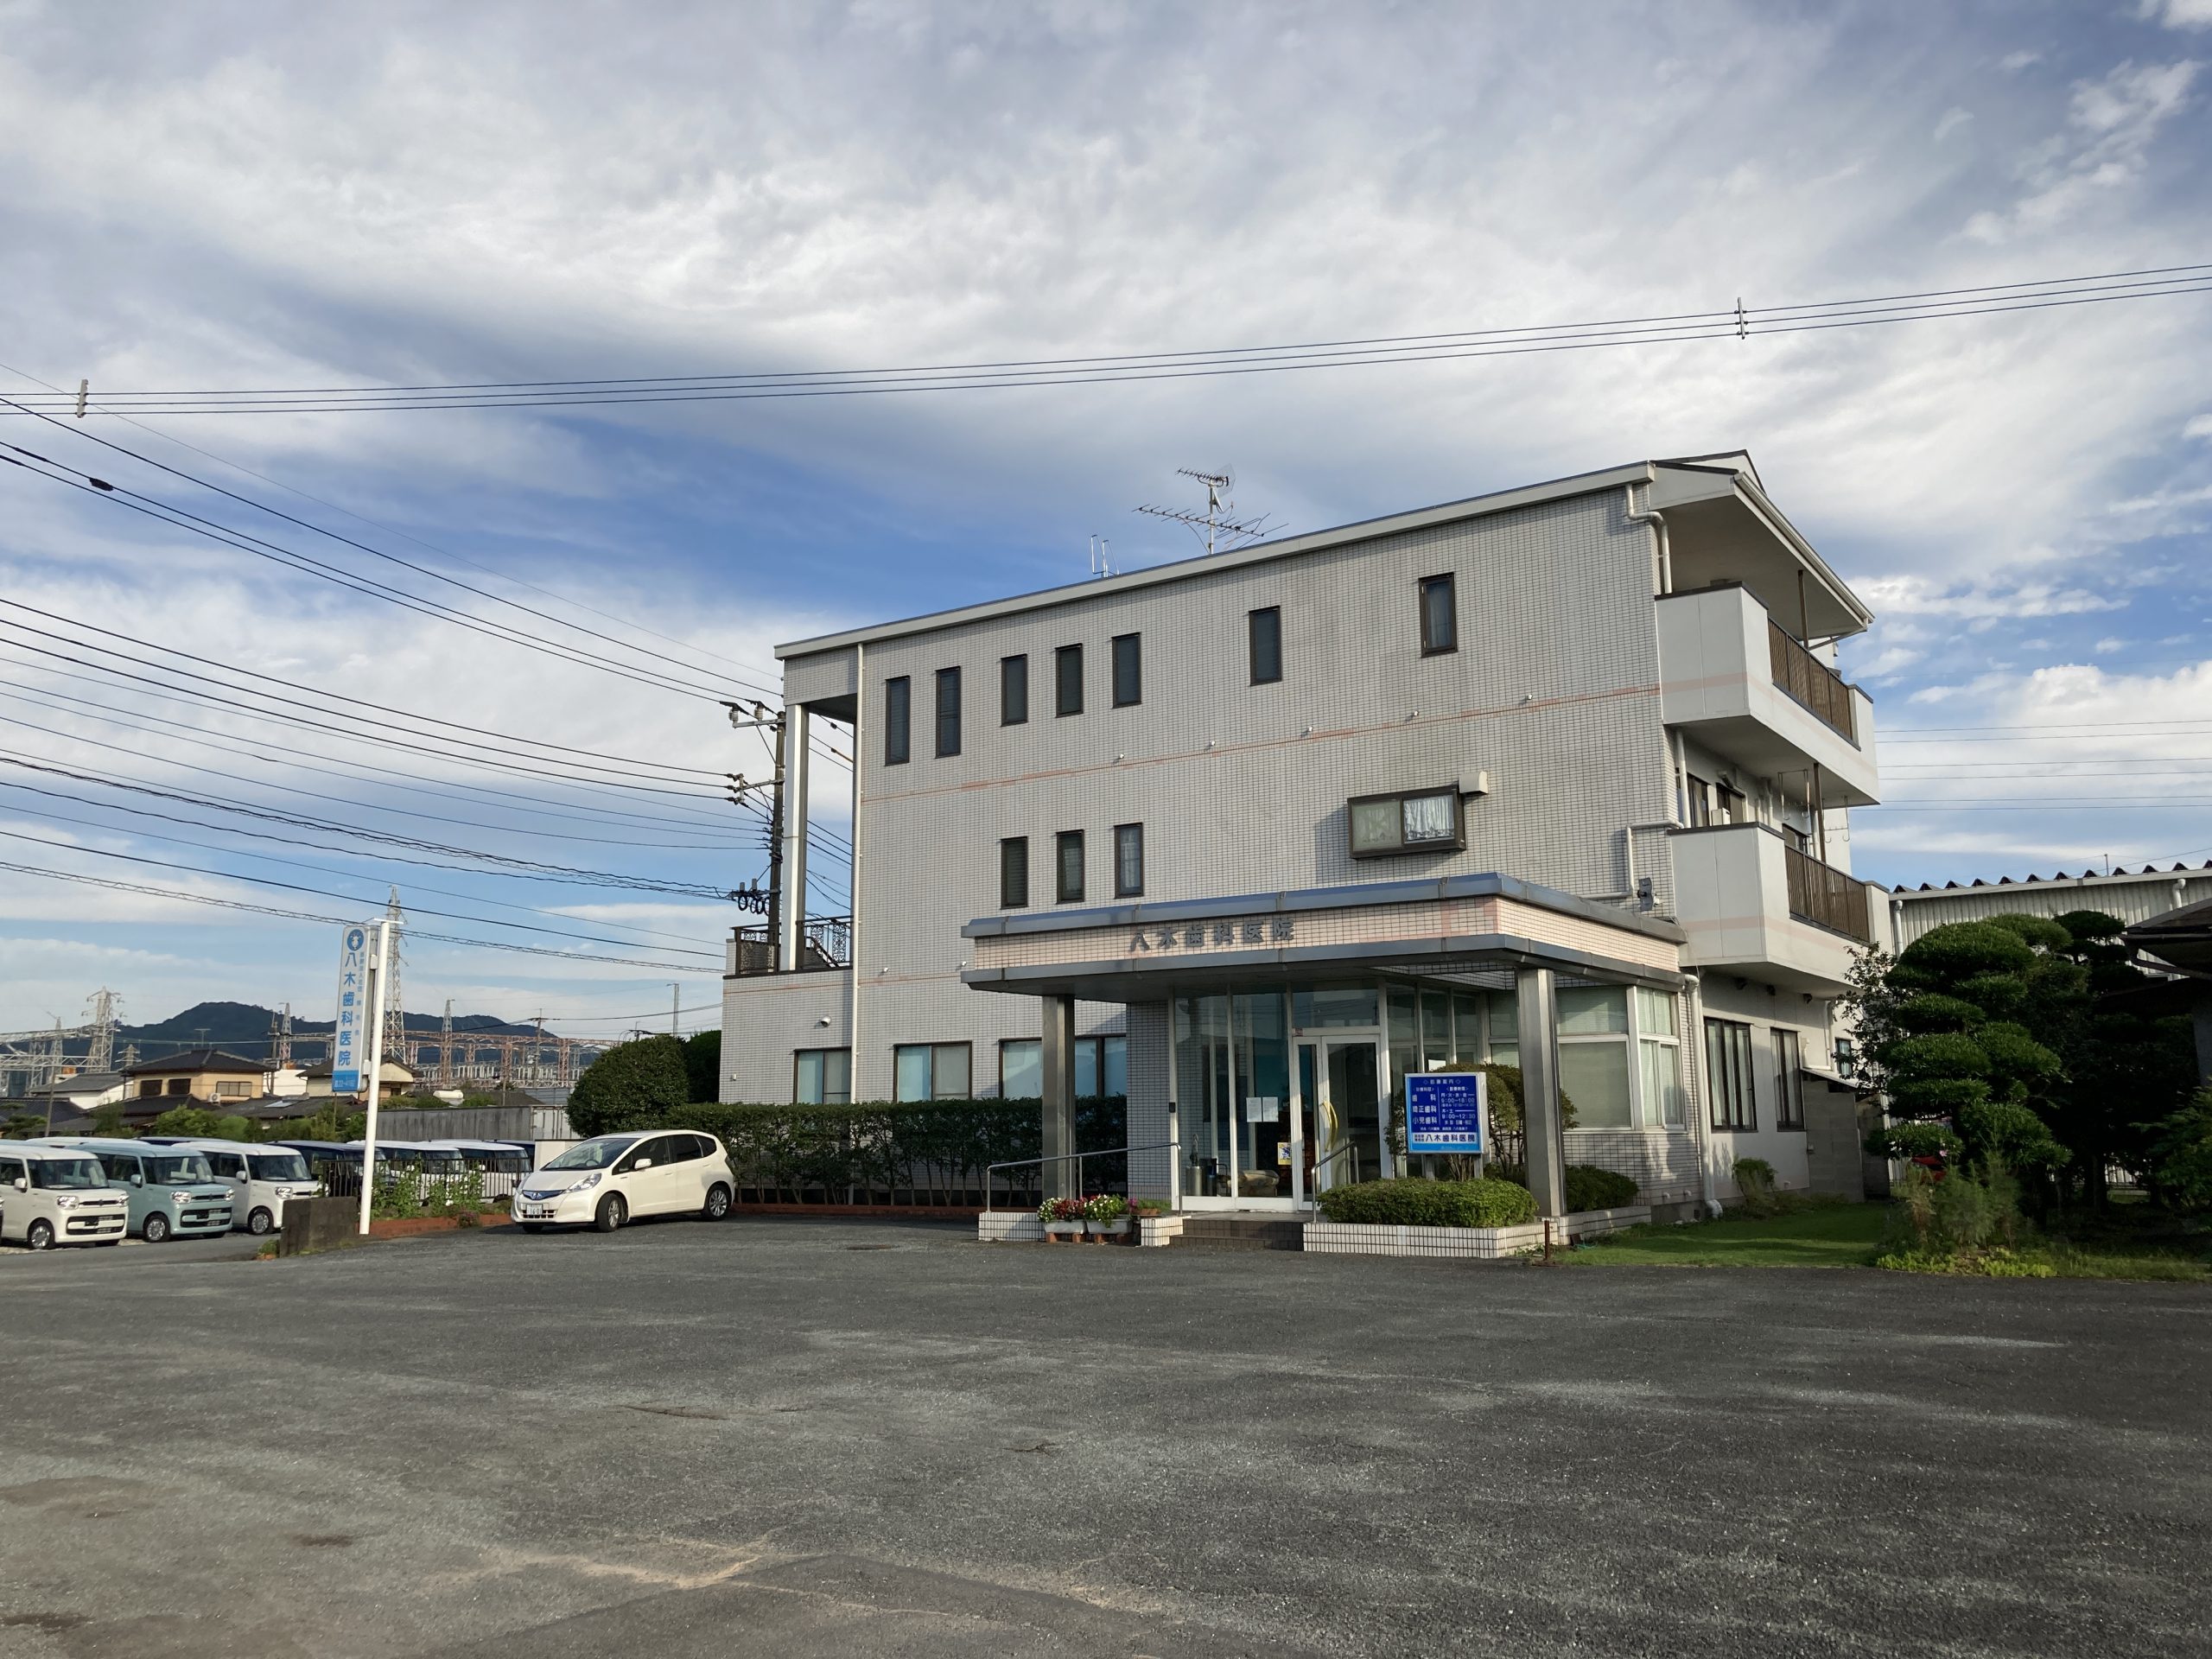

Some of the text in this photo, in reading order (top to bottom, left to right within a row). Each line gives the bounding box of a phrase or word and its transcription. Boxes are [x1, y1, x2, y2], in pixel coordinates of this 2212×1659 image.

[1130, 918, 1294, 951] 八木歯科医院
[338, 951, 358, 1066] 八木歯科医院
